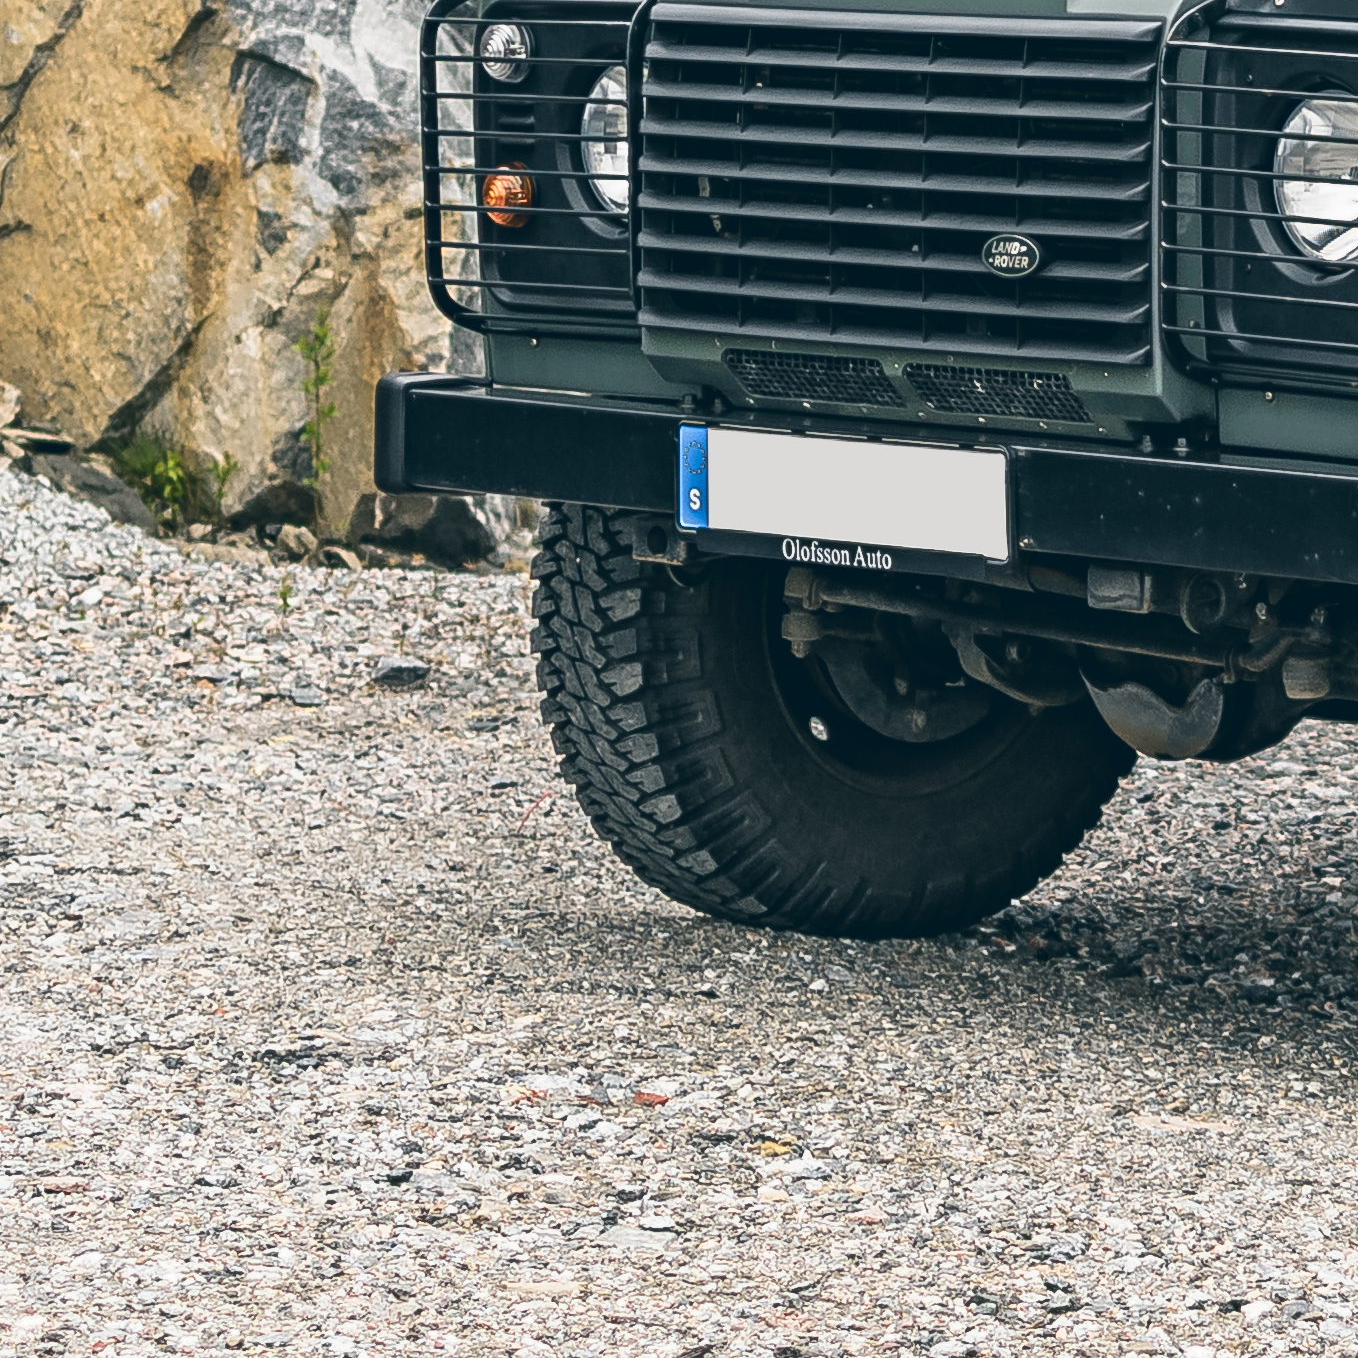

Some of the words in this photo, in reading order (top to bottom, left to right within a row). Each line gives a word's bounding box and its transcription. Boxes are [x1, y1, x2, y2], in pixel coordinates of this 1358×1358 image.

[991, 240, 1020, 254] LAND
[993, 255, 1029, 268] ROVER
[689, 488, 701, 510] S
[781, 538, 851, 565] Olofsson
[853, 545, 892, 570] Auto
